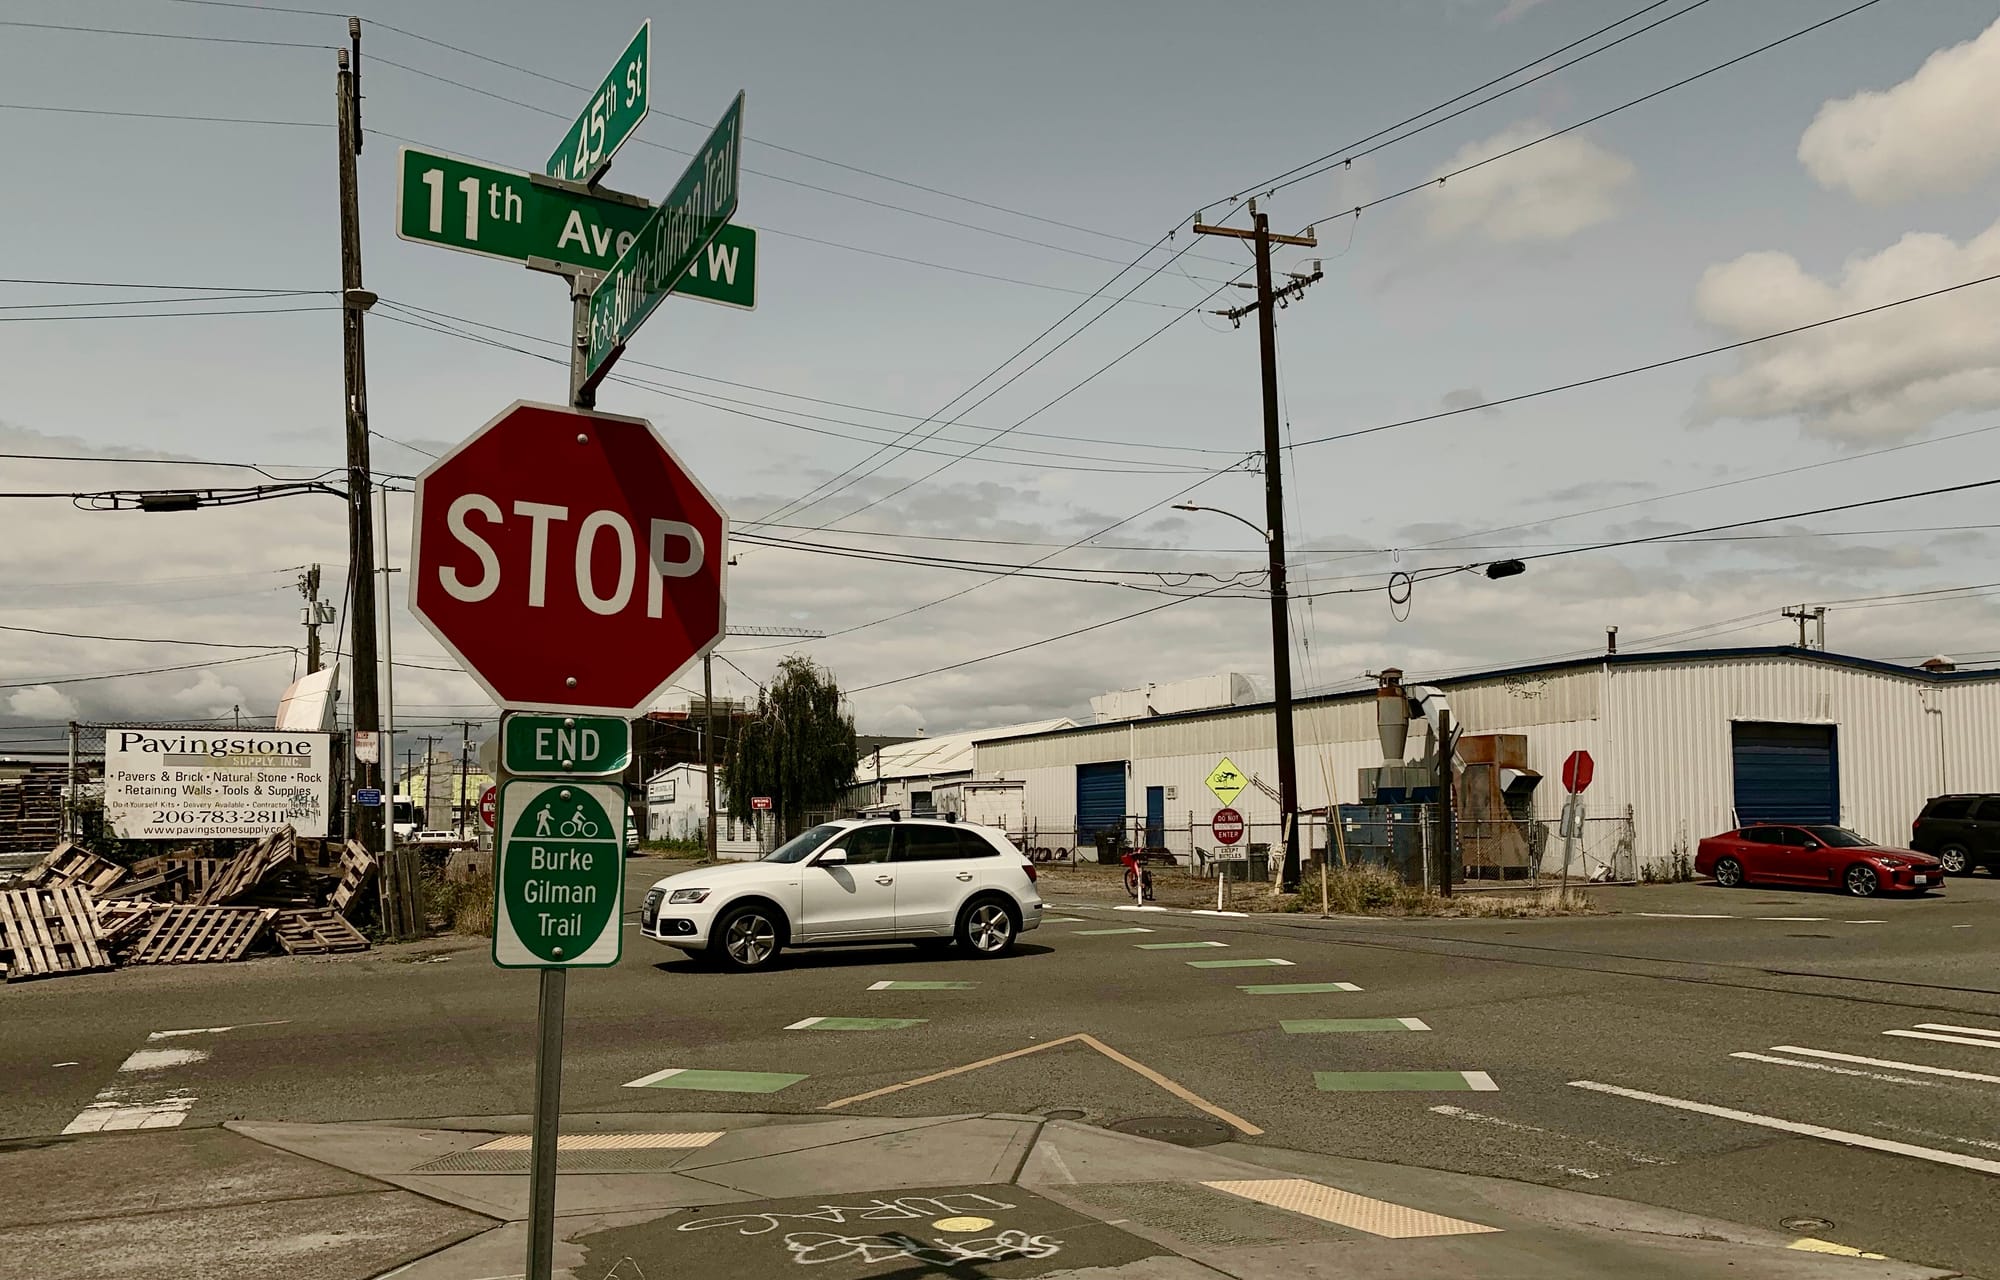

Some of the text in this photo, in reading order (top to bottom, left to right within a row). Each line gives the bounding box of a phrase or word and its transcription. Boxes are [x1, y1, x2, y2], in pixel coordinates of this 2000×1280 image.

[573, 79, 616, 179] 45th
[626, 53, 642, 108] St
[422, 167, 739, 286] 11th Ave W
[613, 115, 736, 336] Burke-Gilman Trail
[438, 492, 705, 619] STOP
[119, 732, 312, 758] Pavingstone
[535, 728, 600, 761] END
[280, 757, 303, 768] INC.
[117, 771, 322, 783] Pavers & Brick Natural Stone Rock
[125, 785, 177, 798] Retaining
[182, 785, 212, 796] Walls
[222, 785, 249, 796] Tools
[254, 785, 263, 796] &
[268, 785, 311, 798] Supplies
[152, 810, 285, 824] 206-783-2811
[1218, 831, 1239, 839] ENTER
[531, 847, 594, 871] Burke
[524, 879, 596, 904] Gilman
[538, 913, 582, 936] Trail
